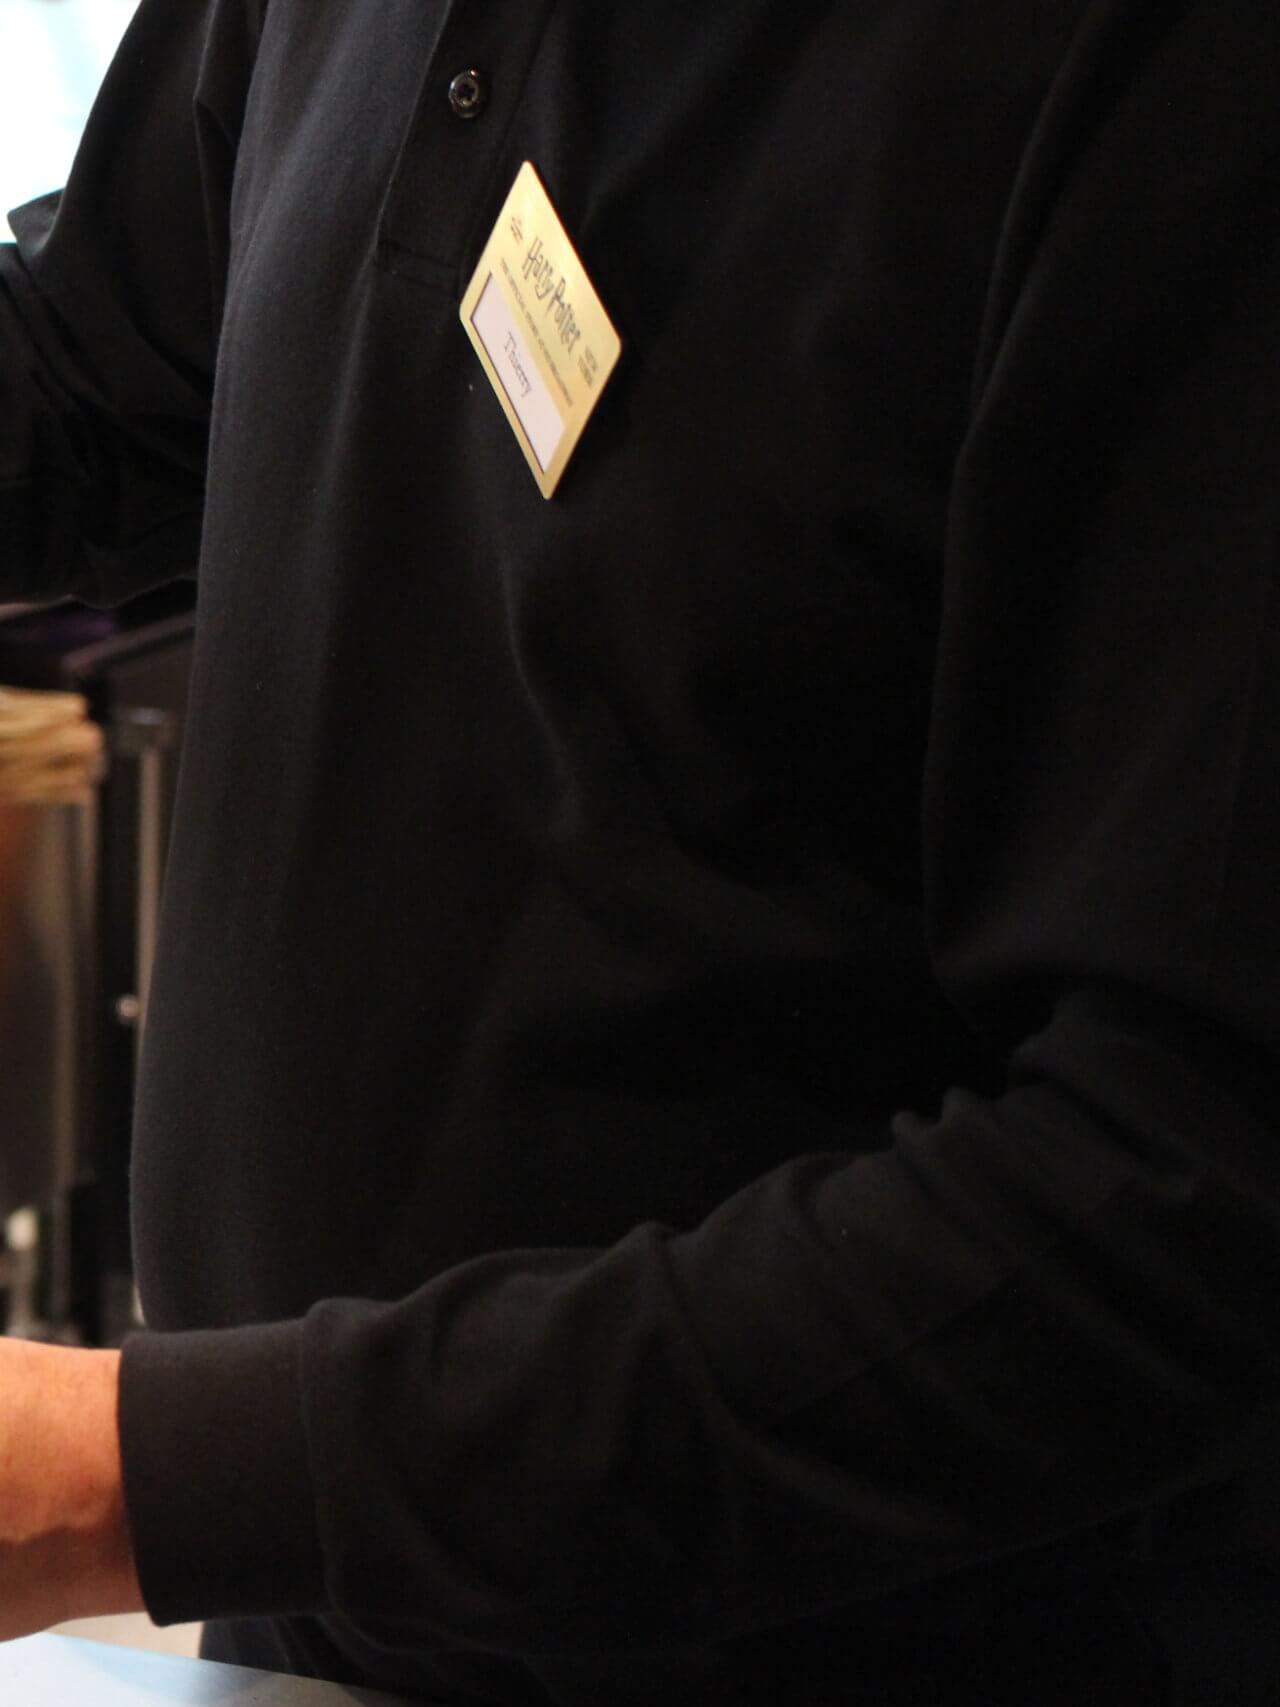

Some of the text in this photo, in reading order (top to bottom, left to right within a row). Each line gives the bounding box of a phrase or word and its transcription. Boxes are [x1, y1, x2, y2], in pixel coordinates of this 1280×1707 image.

[521, 236, 554, 301] Harry
[545, 275, 581, 354] Potter
[503, 329, 533, 398] Thierry
